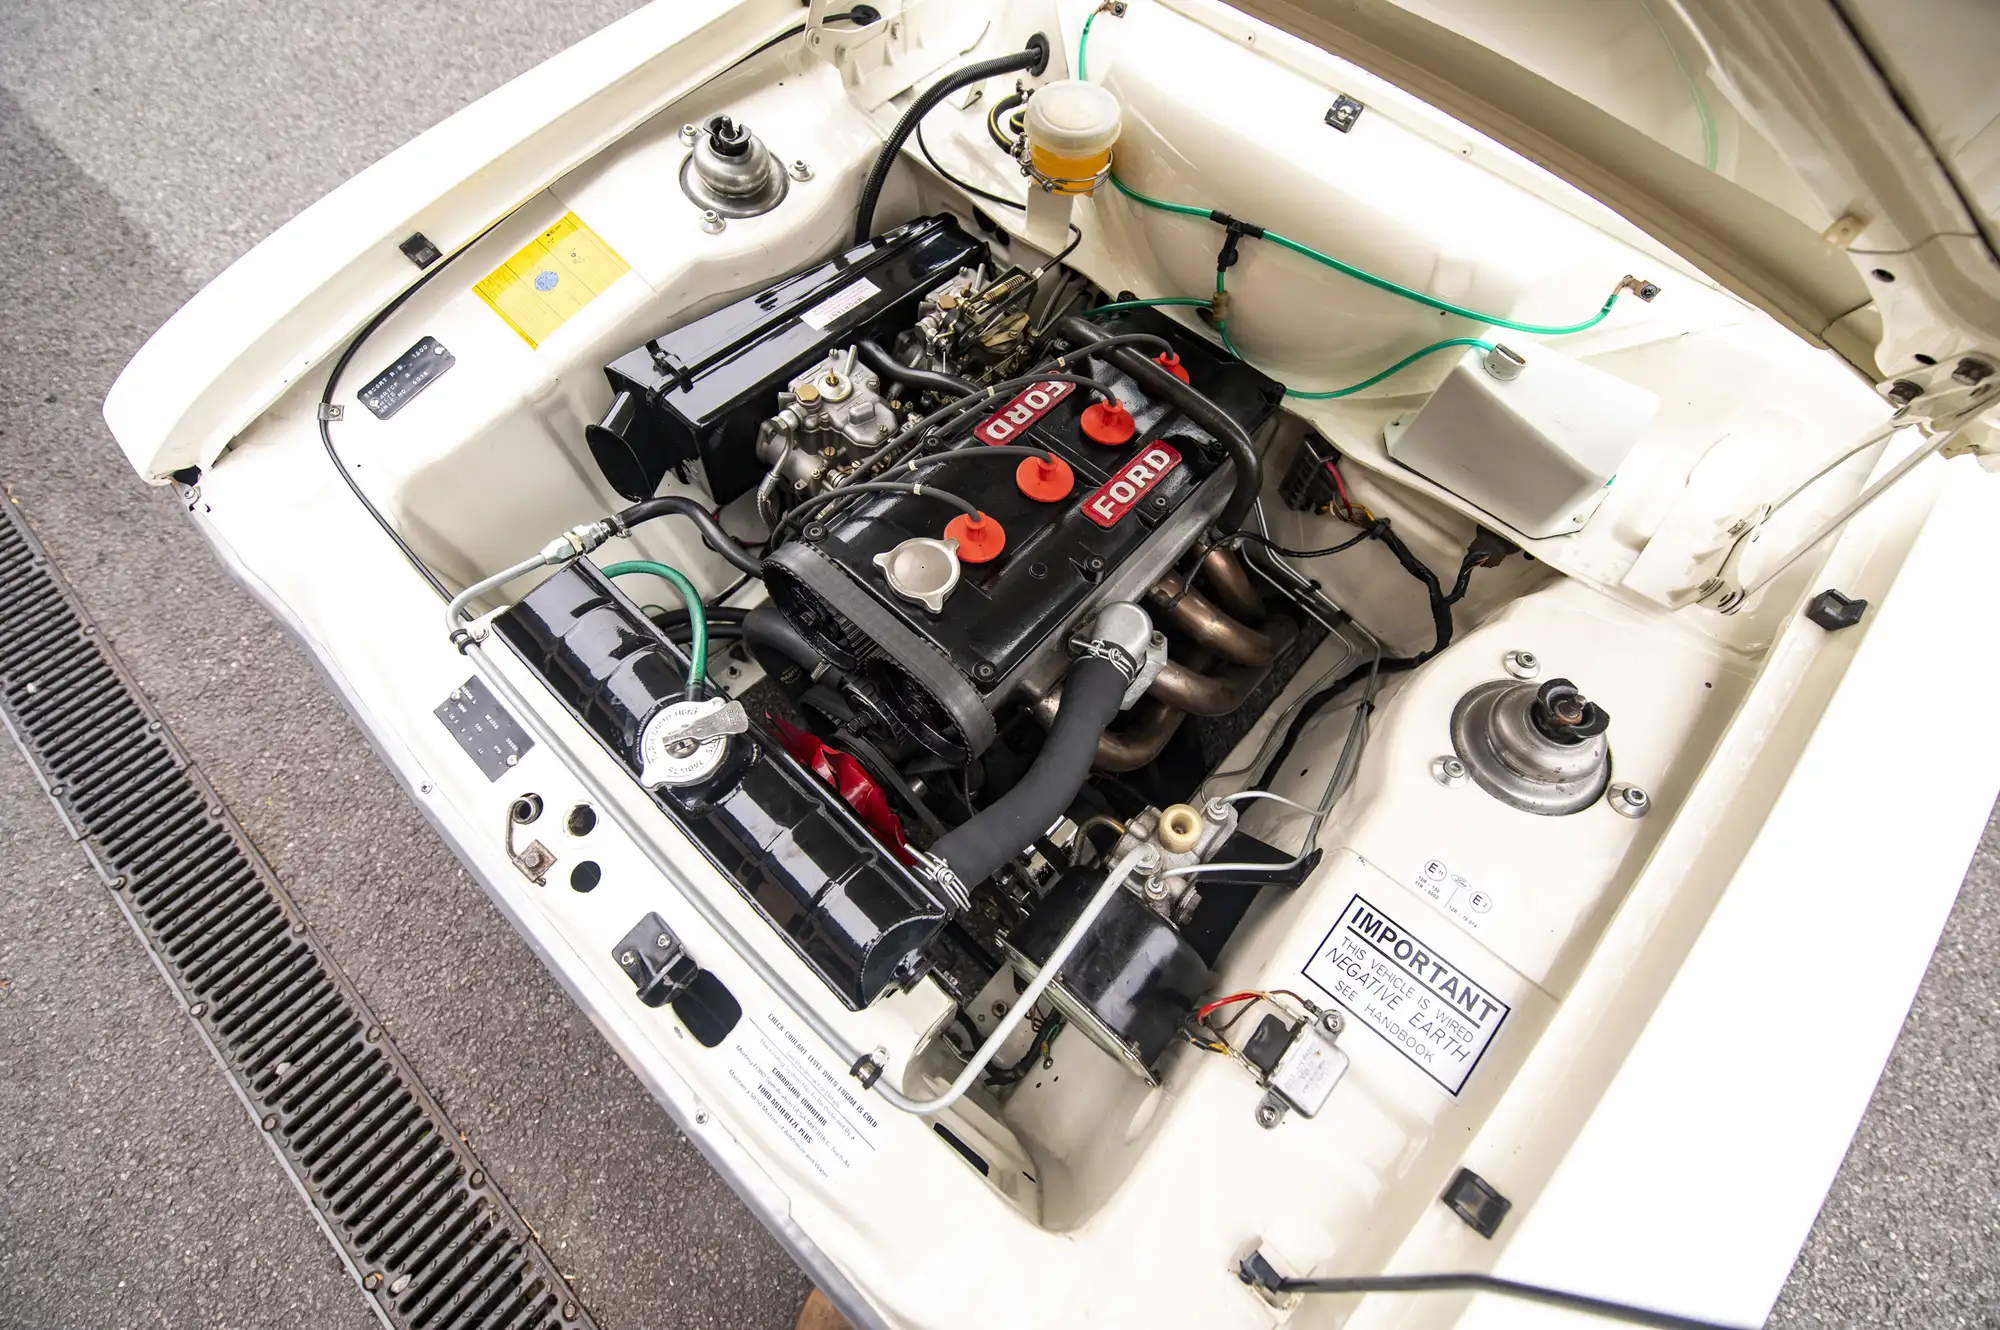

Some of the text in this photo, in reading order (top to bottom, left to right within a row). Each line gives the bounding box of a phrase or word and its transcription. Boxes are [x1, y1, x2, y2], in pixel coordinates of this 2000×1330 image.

[986, 381, 1066, 440] FORD
[1091, 450, 1169, 519] FORD
[1427, 862, 1438, 873] E
[1472, 894, 1482, 905] E
[1341, 935, 1473, 1042] THIS VEHICLE IS WIRED
[1350, 906, 1498, 1021] IMPORTANT
[1325, 948, 1470, 1062] NEGATIVE EARTH
[1333, 979, 1435, 1063] SEE HANDBOOK
[767, 1012, 785, 1031] CHECK
[783, 1030, 808, 1055] COOLANT
[806, 1054, 822, 1070] LEVEL
[837, 1085, 857, 1106] ENGINE
[855, 1104, 864, 1114] IS
[862, 1111, 878, 1128] COLD
[771, 1066, 828, 1126] CORROSION INHIBITOR
[770, 1098, 799, 1128] ANTIFREEZE
